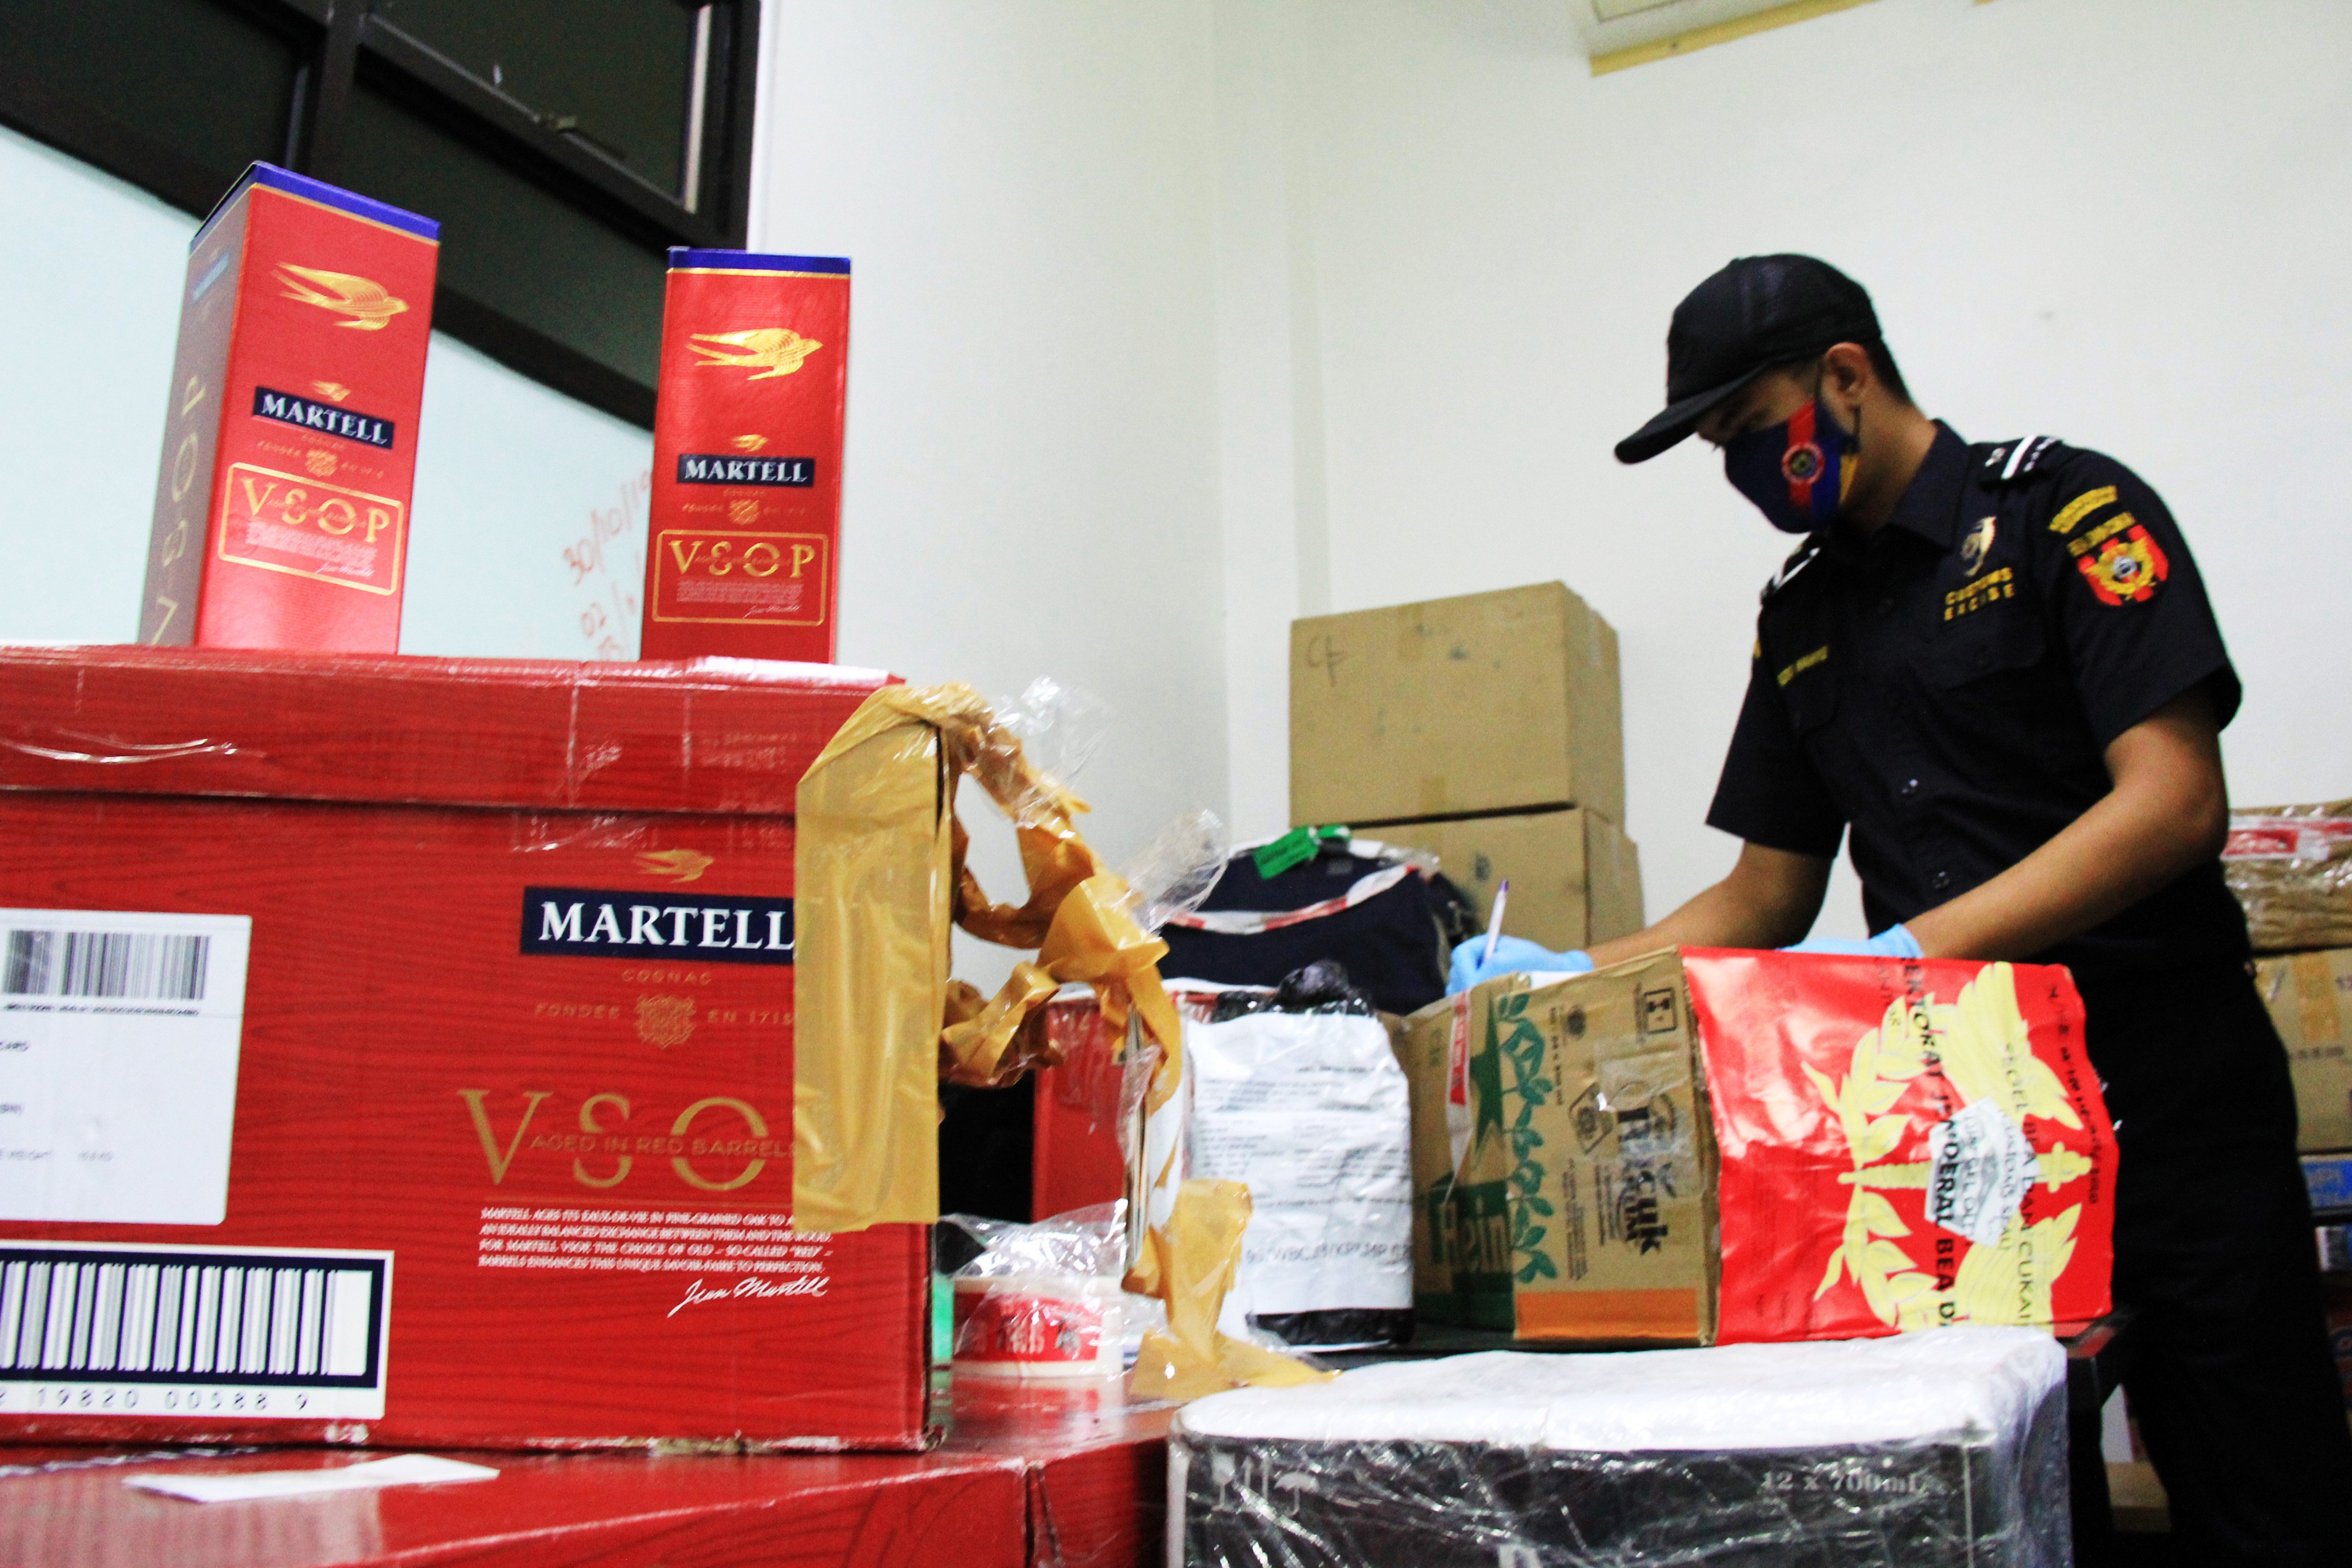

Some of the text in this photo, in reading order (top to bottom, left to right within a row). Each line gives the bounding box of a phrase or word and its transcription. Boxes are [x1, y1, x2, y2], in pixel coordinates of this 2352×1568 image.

[261, 393, 388, 445] MARTELL
[684, 458, 808, 482] MARTELL
[240, 477, 390, 543] VSOP
[668, 540, 815, 578] VSOP
[538, 901, 794, 950] MARTELL
[621, 969, 712, 985] COGNAC
[707, 1009, 737, 1023] EN
[529, 1134, 596, 1152] AGED
[605, 1136, 627, 1152] IN
[636, 1137, 684, 1155] RED
[1937, 1238, 1958, 1292] BEA
[37, 1387, 310, 1411] 19820 00588 9
